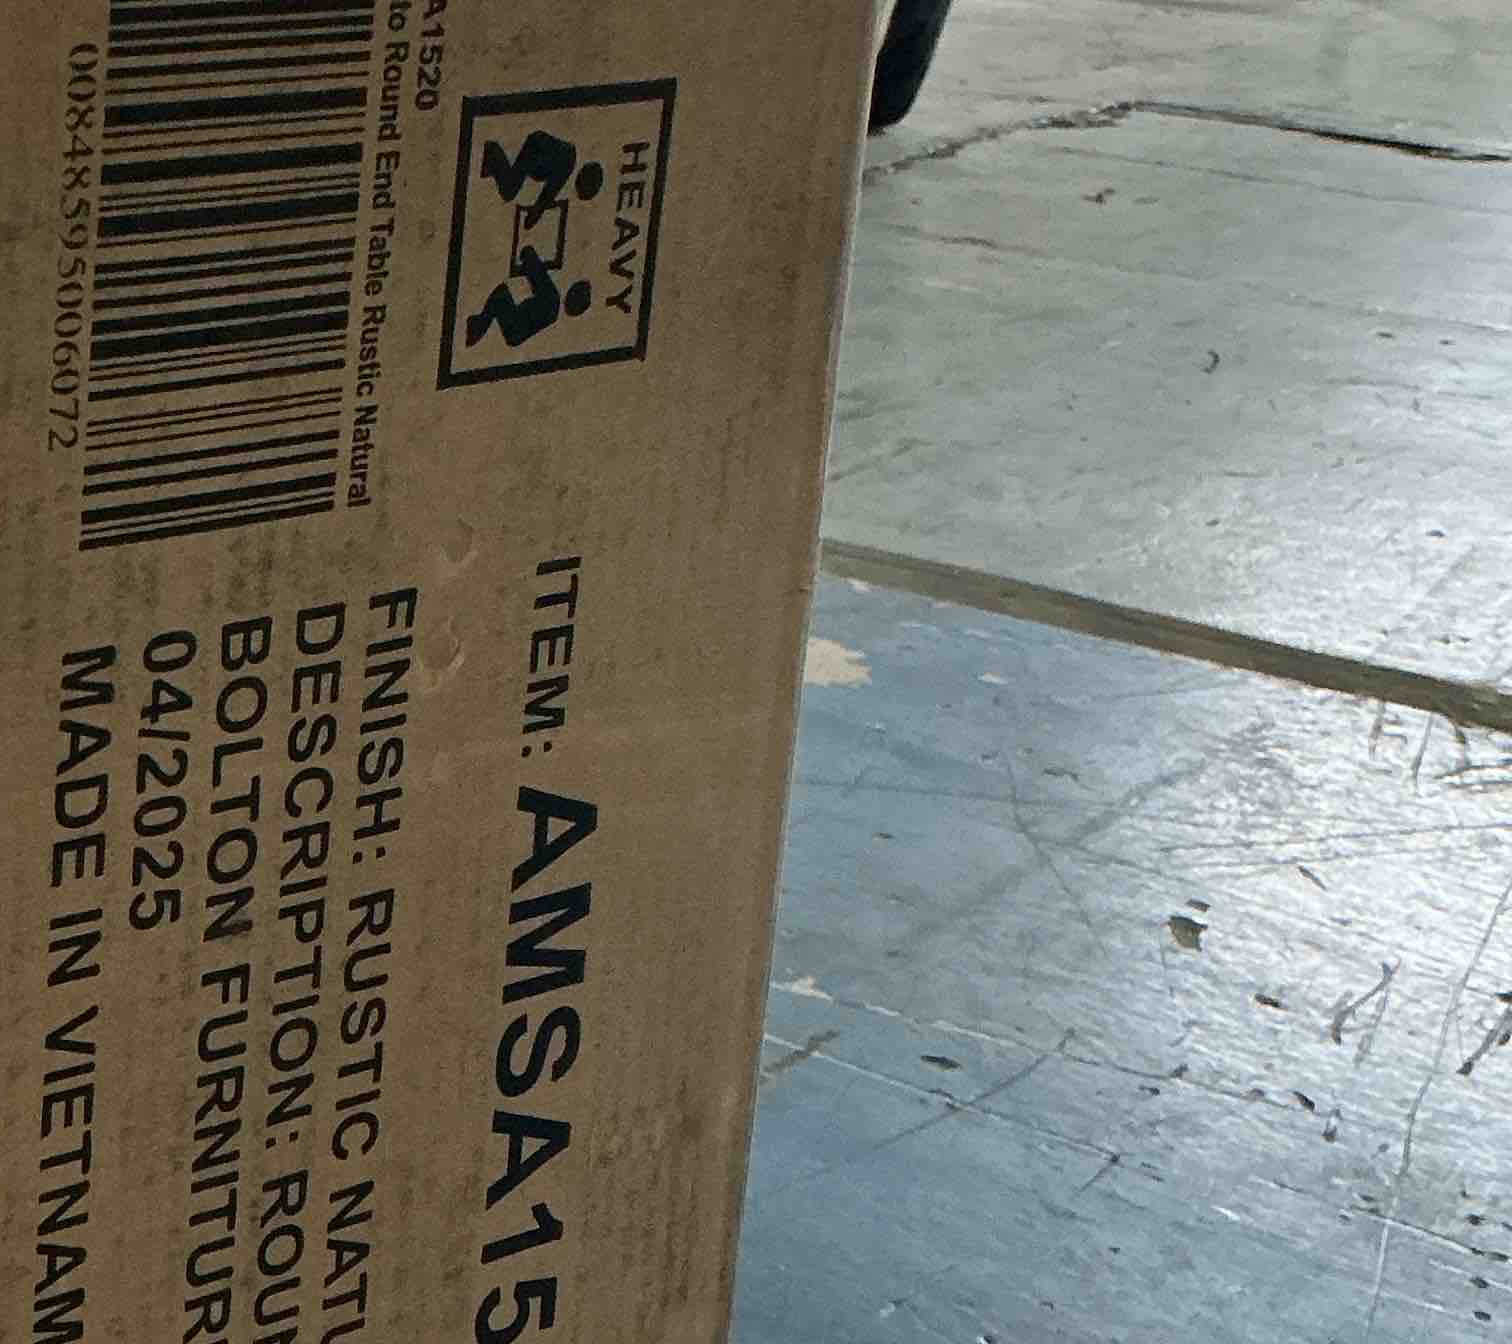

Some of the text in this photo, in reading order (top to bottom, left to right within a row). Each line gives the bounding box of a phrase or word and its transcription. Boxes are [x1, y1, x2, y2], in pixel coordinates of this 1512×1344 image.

[372, 151, 400, 209] End
[377, 42, 409, 141] Round
[47, 44, 97, 451] 00848595006072
[364, 217, 394, 295] Table
[605, 143, 649, 313] HEAVY
[356, 305, 386, 397] Rustic
[346, 405, 378, 507] Natural
[352, 588, 418, 864] FINISH:
[521, 557, 581, 757] ITEM:
[50, 645, 116, 887] MADE
[128, 631, 197, 930] 04/2025
[203, 616, 272, 942] BOLTON
[46, 908, 102, 987] IN
[265, 602, 346, 1148] DESCRIPTION:
[331, 888, 394, 1160] RUSTIC
